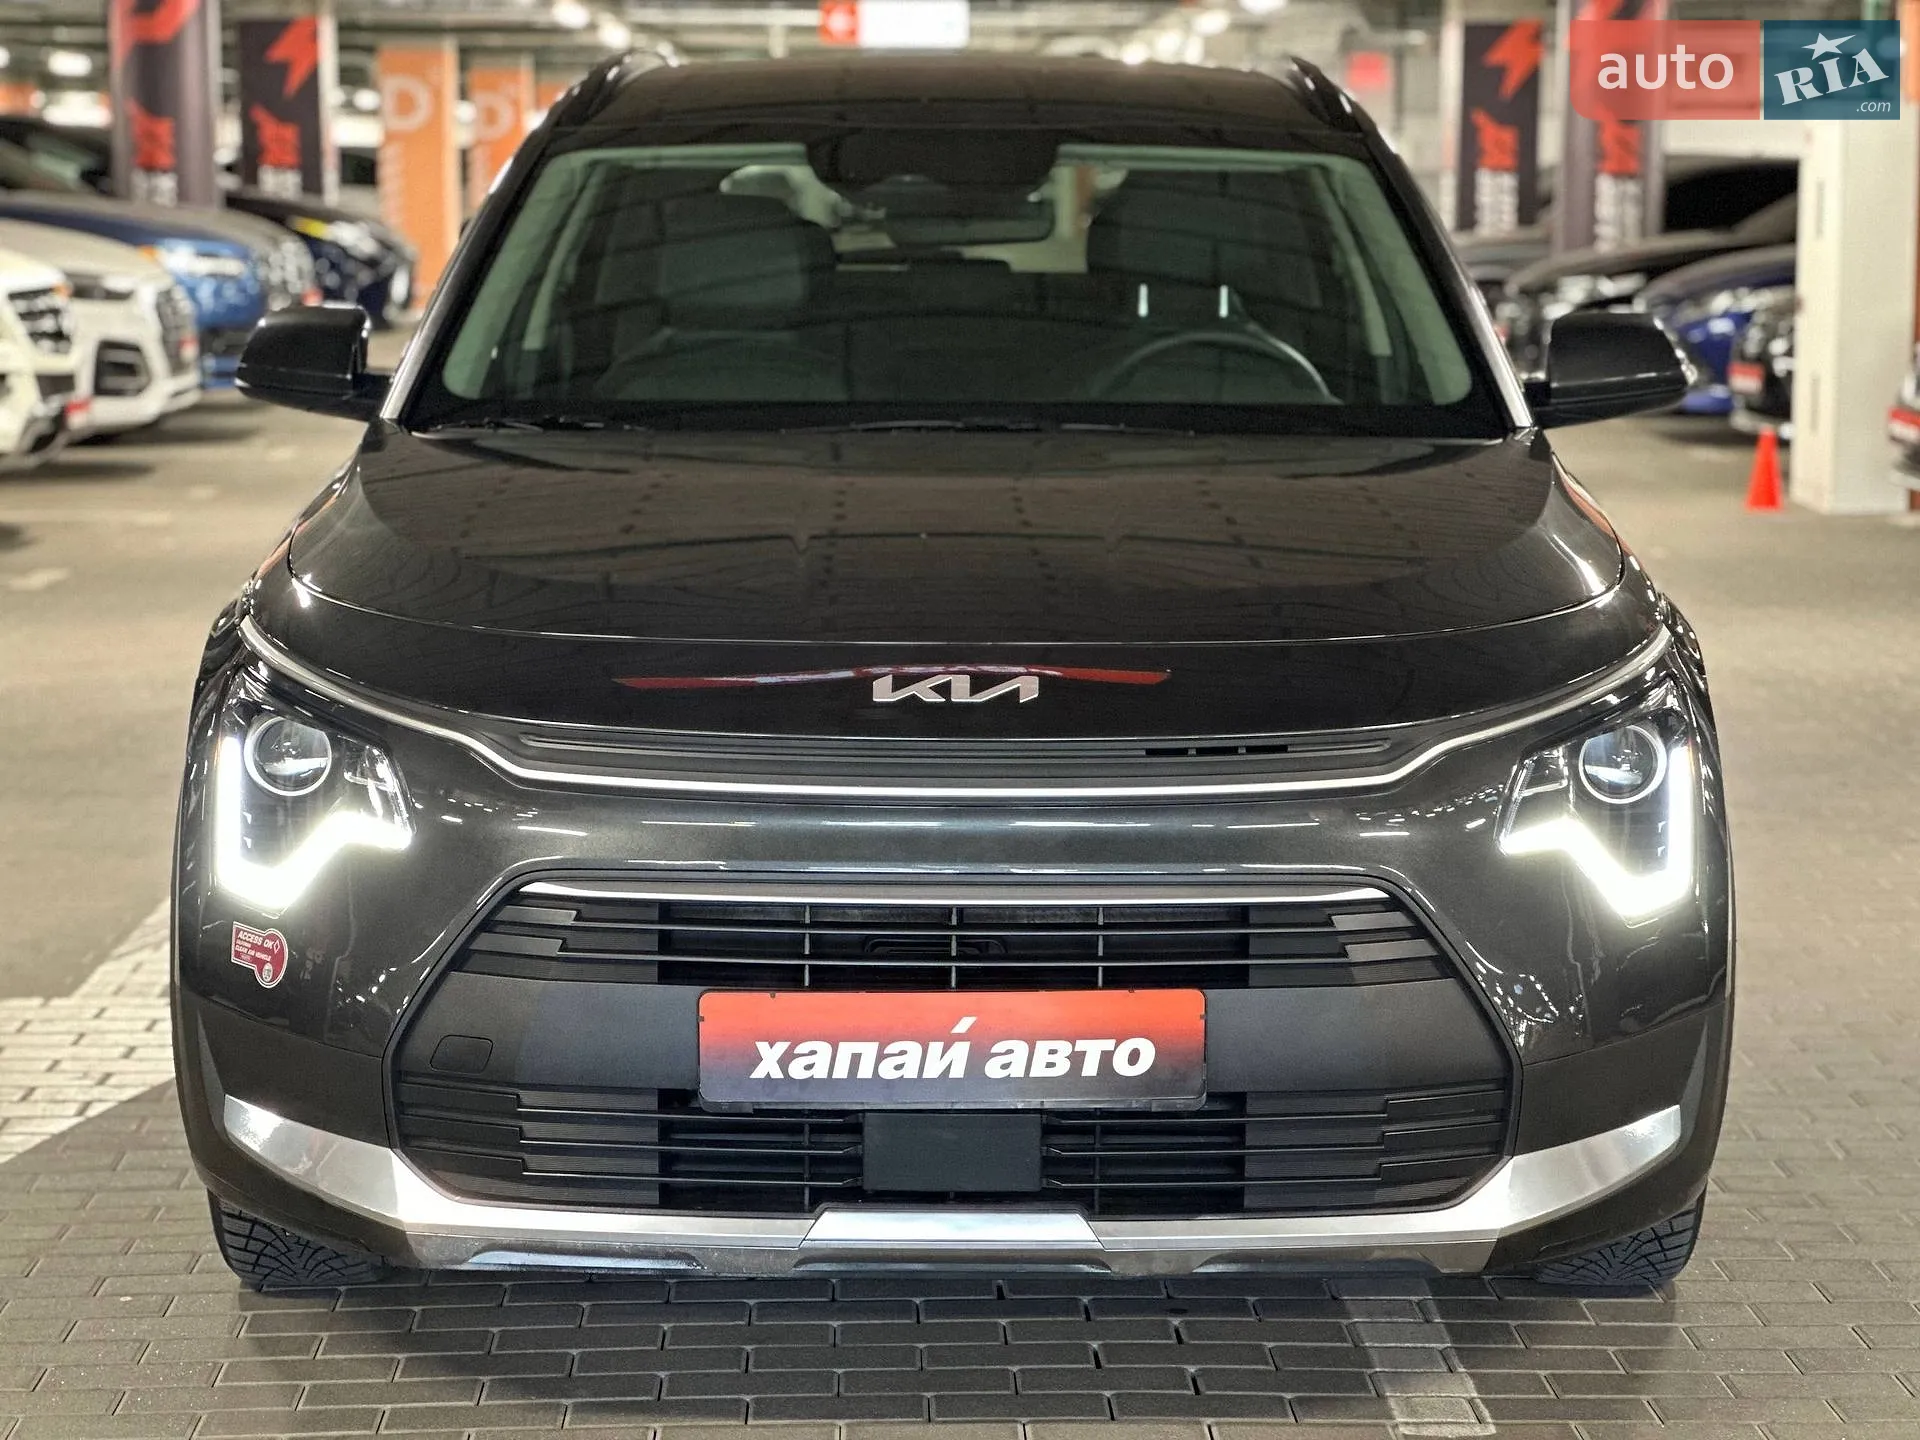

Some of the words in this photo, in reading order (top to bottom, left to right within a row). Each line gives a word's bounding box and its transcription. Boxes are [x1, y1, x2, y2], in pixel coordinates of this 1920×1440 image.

[873, 674, 1039, 703] KIA
[238, 930, 263, 945] ACCESS
[263, 939, 274, 949] OK
[984, 1037, 1156, 1078] авто
